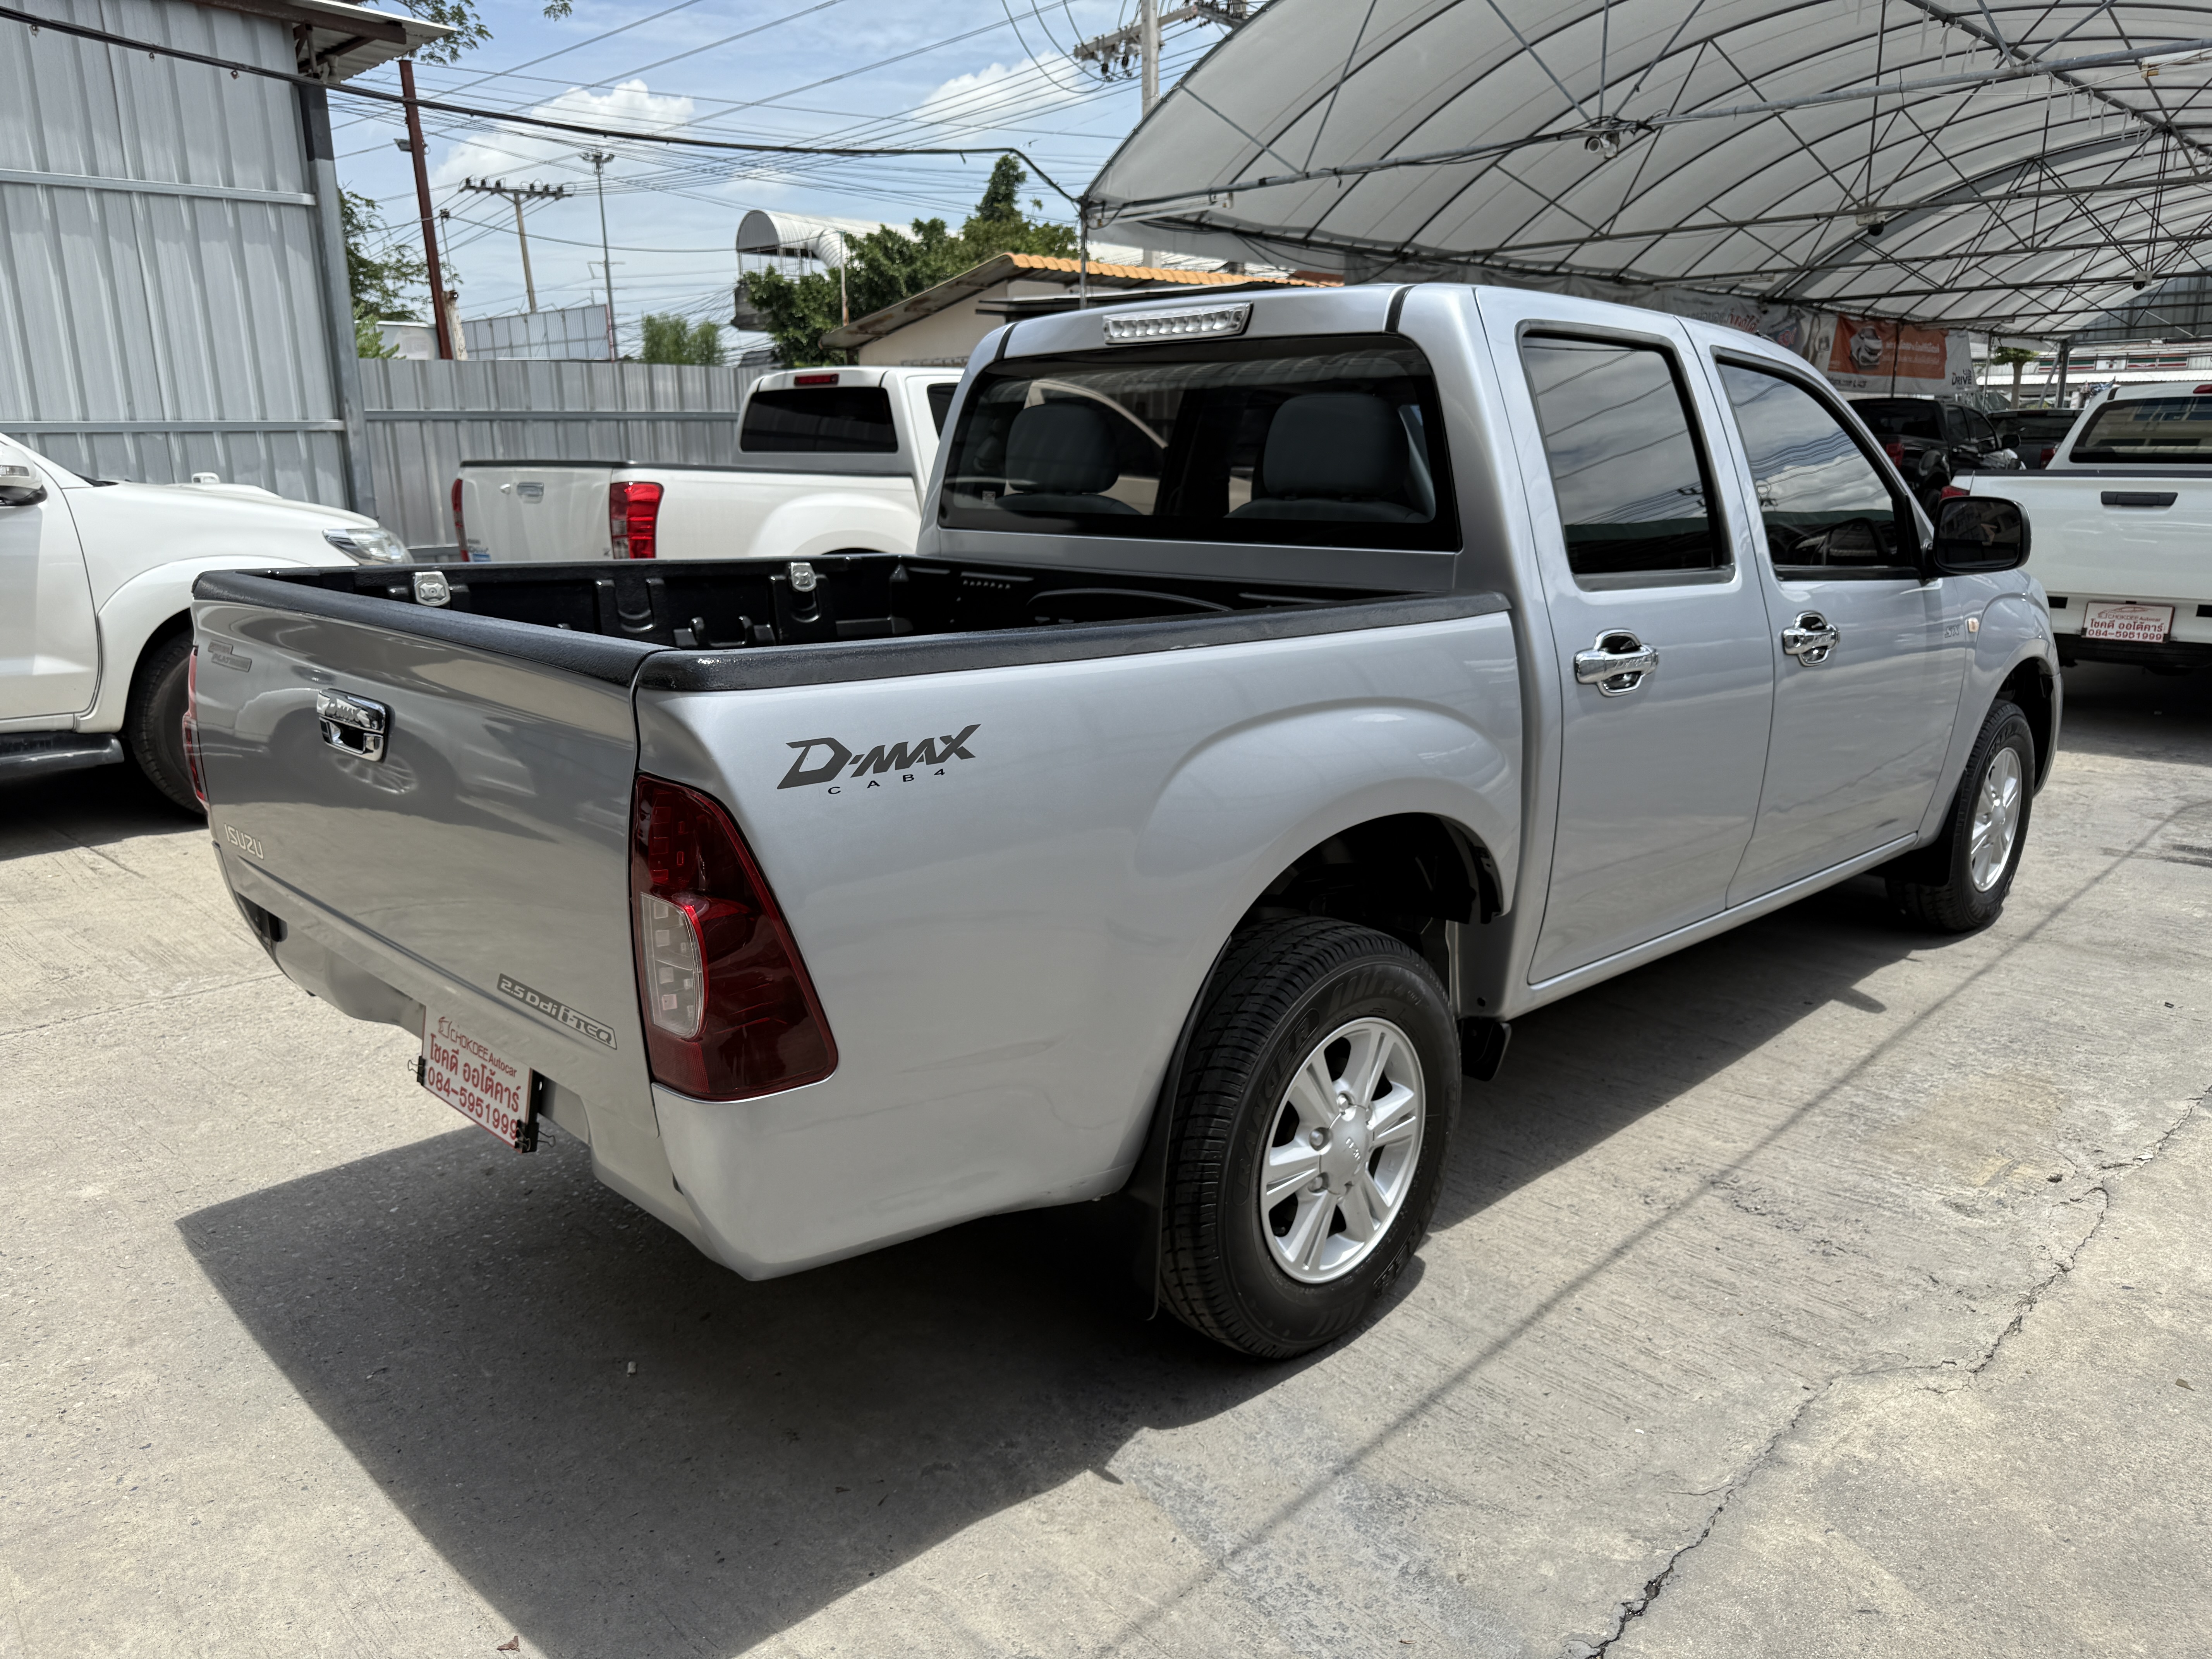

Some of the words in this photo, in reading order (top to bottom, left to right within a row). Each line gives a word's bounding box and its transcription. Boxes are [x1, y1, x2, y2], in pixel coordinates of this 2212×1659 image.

[2088, 628, 2162, 641] 084-5951999
[2090, 618, 2115, 629] โชคดี
[777, 723, 982, 790] D-MAX
[224, 823, 264, 860] ISUZU
[500, 978, 525, 998] 2.5
[430, 1033, 460, 1075] โชคดี
[450, 1029, 488, 1062] CHOKDEE
[488, 1053, 517, 1078] Autocar
[428, 1066, 518, 1140] 084-5951999
